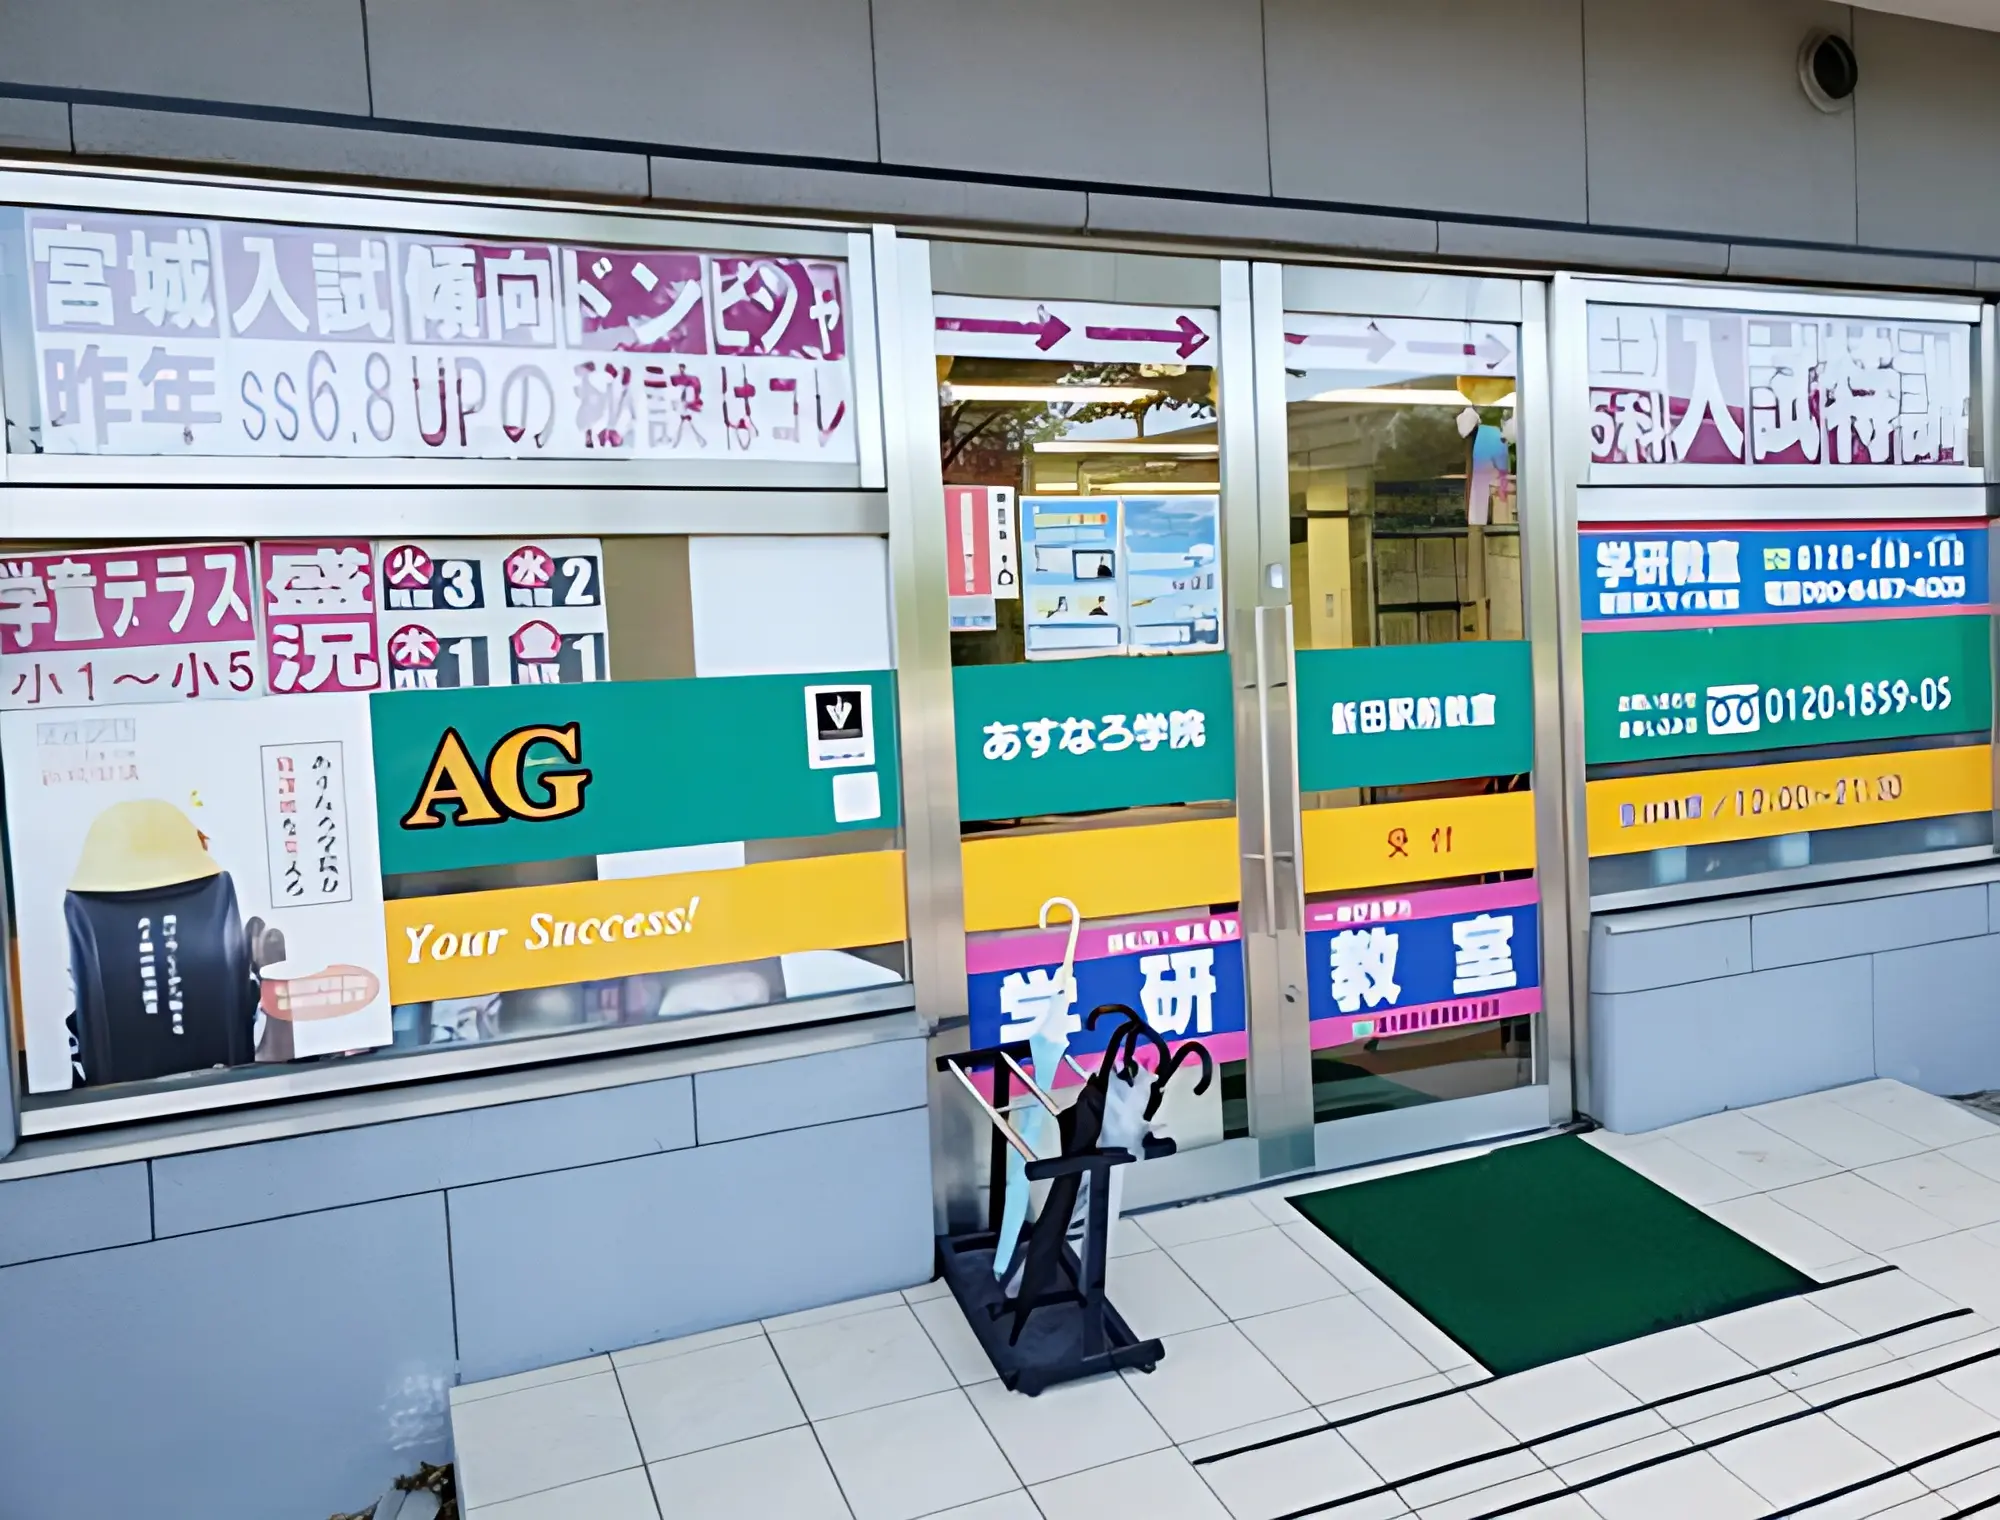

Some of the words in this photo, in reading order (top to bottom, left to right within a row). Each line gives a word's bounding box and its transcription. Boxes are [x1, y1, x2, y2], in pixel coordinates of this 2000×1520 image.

[982, 708, 1206, 761] あすなろ学院
[399, 720, 593, 831] AG
[406, 922, 509, 964] Your
